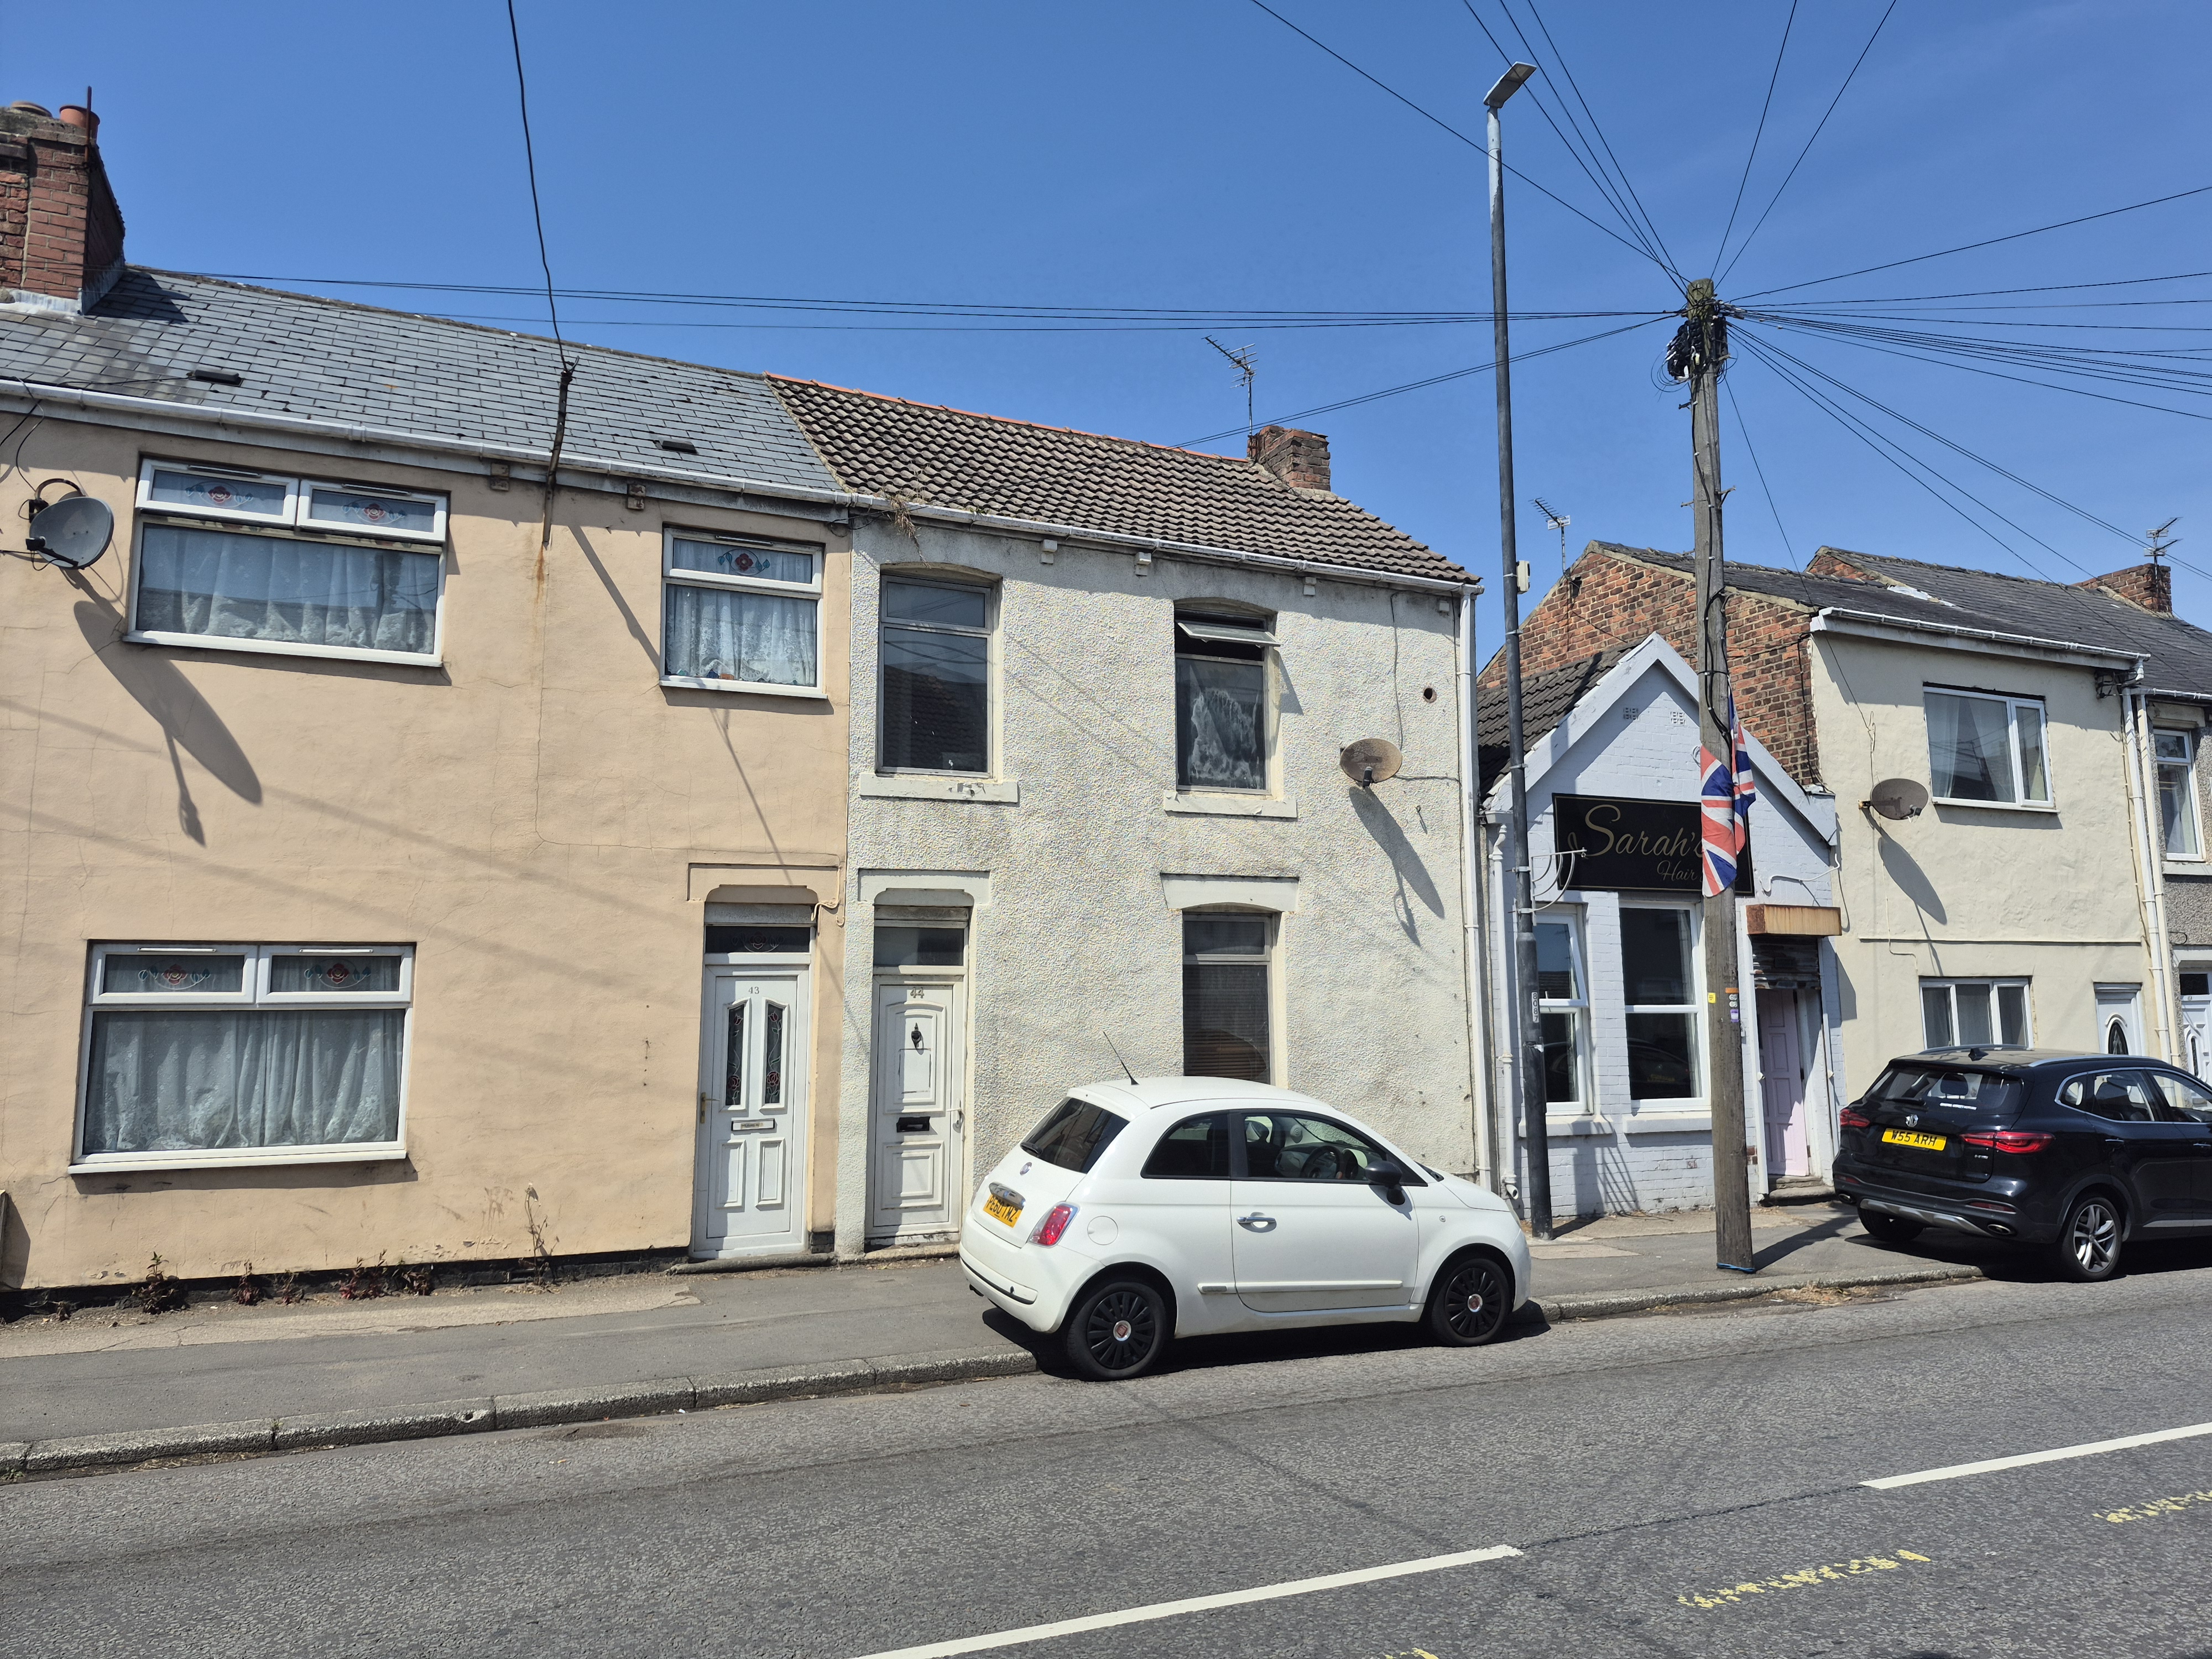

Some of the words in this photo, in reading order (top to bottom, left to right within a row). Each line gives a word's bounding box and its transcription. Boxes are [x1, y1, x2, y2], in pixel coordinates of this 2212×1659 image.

[1657, 860, 1697, 881] Hair
[748, 986, 760, 994] 43
[910, 987, 925, 999] 44
[1891, 1130, 1913, 1142] W55
[1914, 1134, 1937, 1146] ARH
[986, 1196, 1005, 1214] PE60
